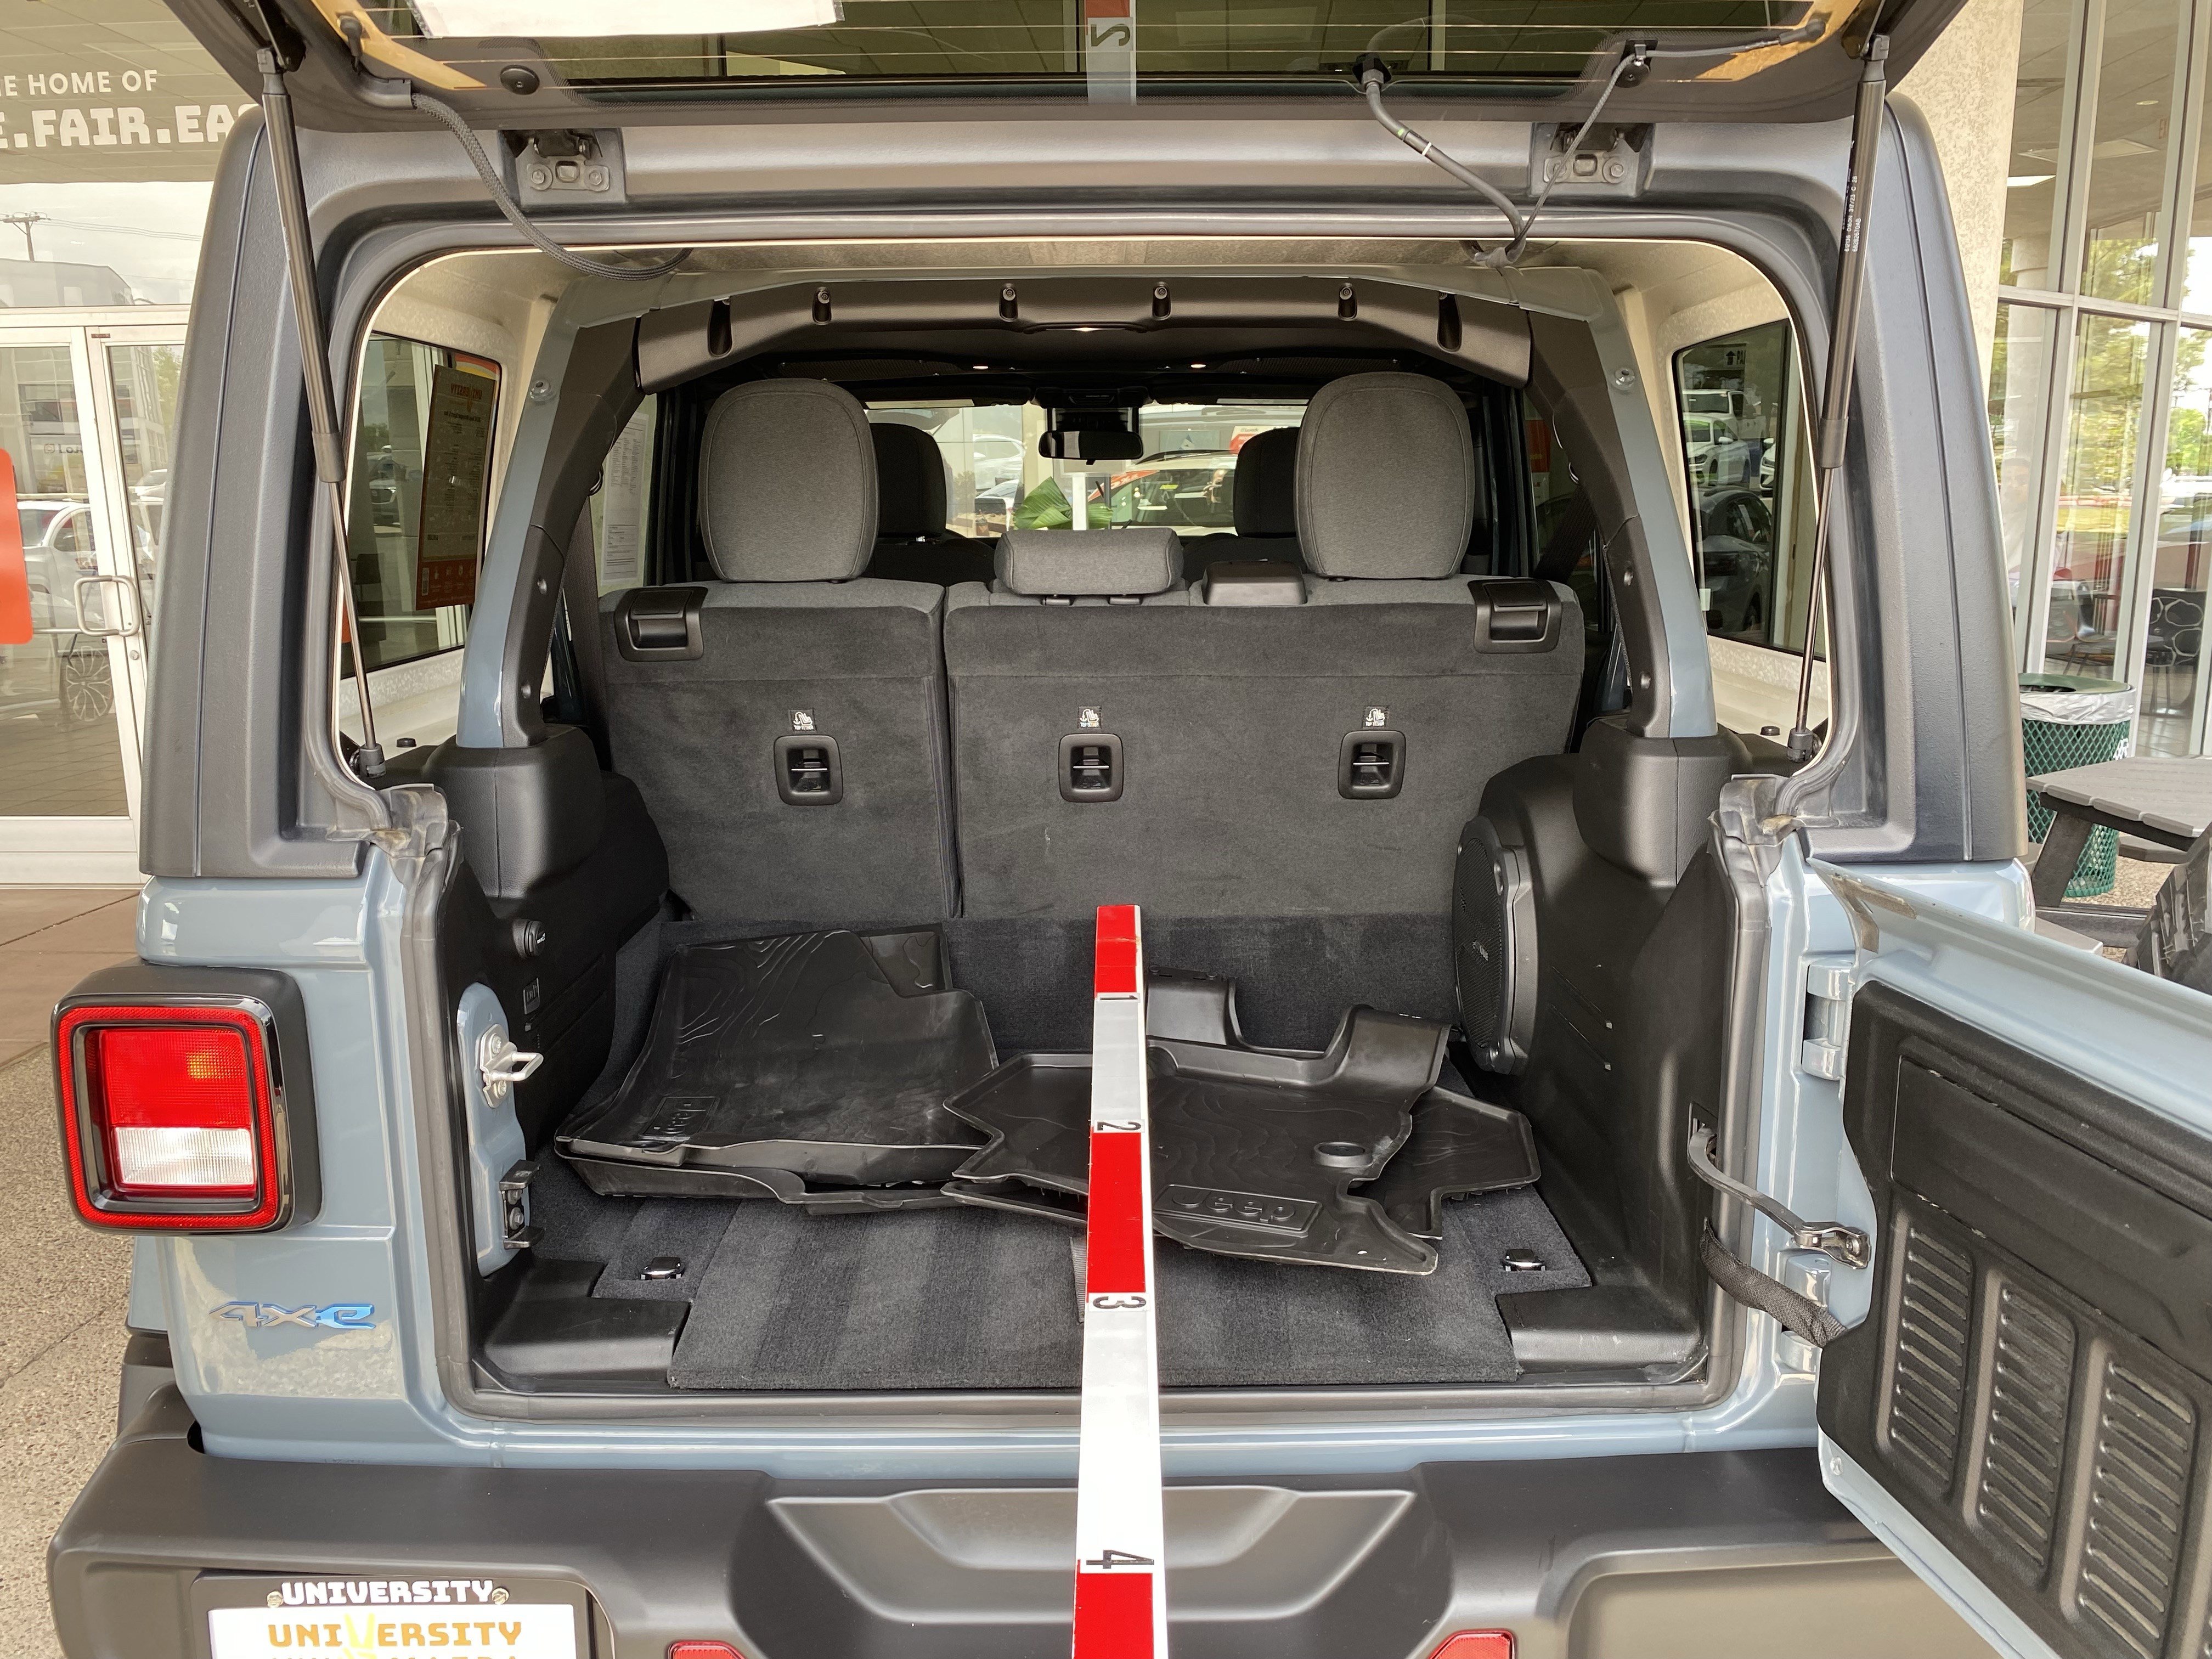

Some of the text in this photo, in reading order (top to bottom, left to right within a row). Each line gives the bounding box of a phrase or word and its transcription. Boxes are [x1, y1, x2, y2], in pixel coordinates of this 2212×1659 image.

[27, 72, 112, 95] HOME
[121, 70, 158, 92] OF
[1097, 1121, 1141, 1131] 2
[1172, 1189, 1295, 1222] Jeep
[1093, 1296, 1147, 1309] 3
[1086, 1550, 1155, 1569] 4
[281, 1580, 493, 1605] UNIVERSITY
[268, 1614, 522, 1649] UNIVERSITY
